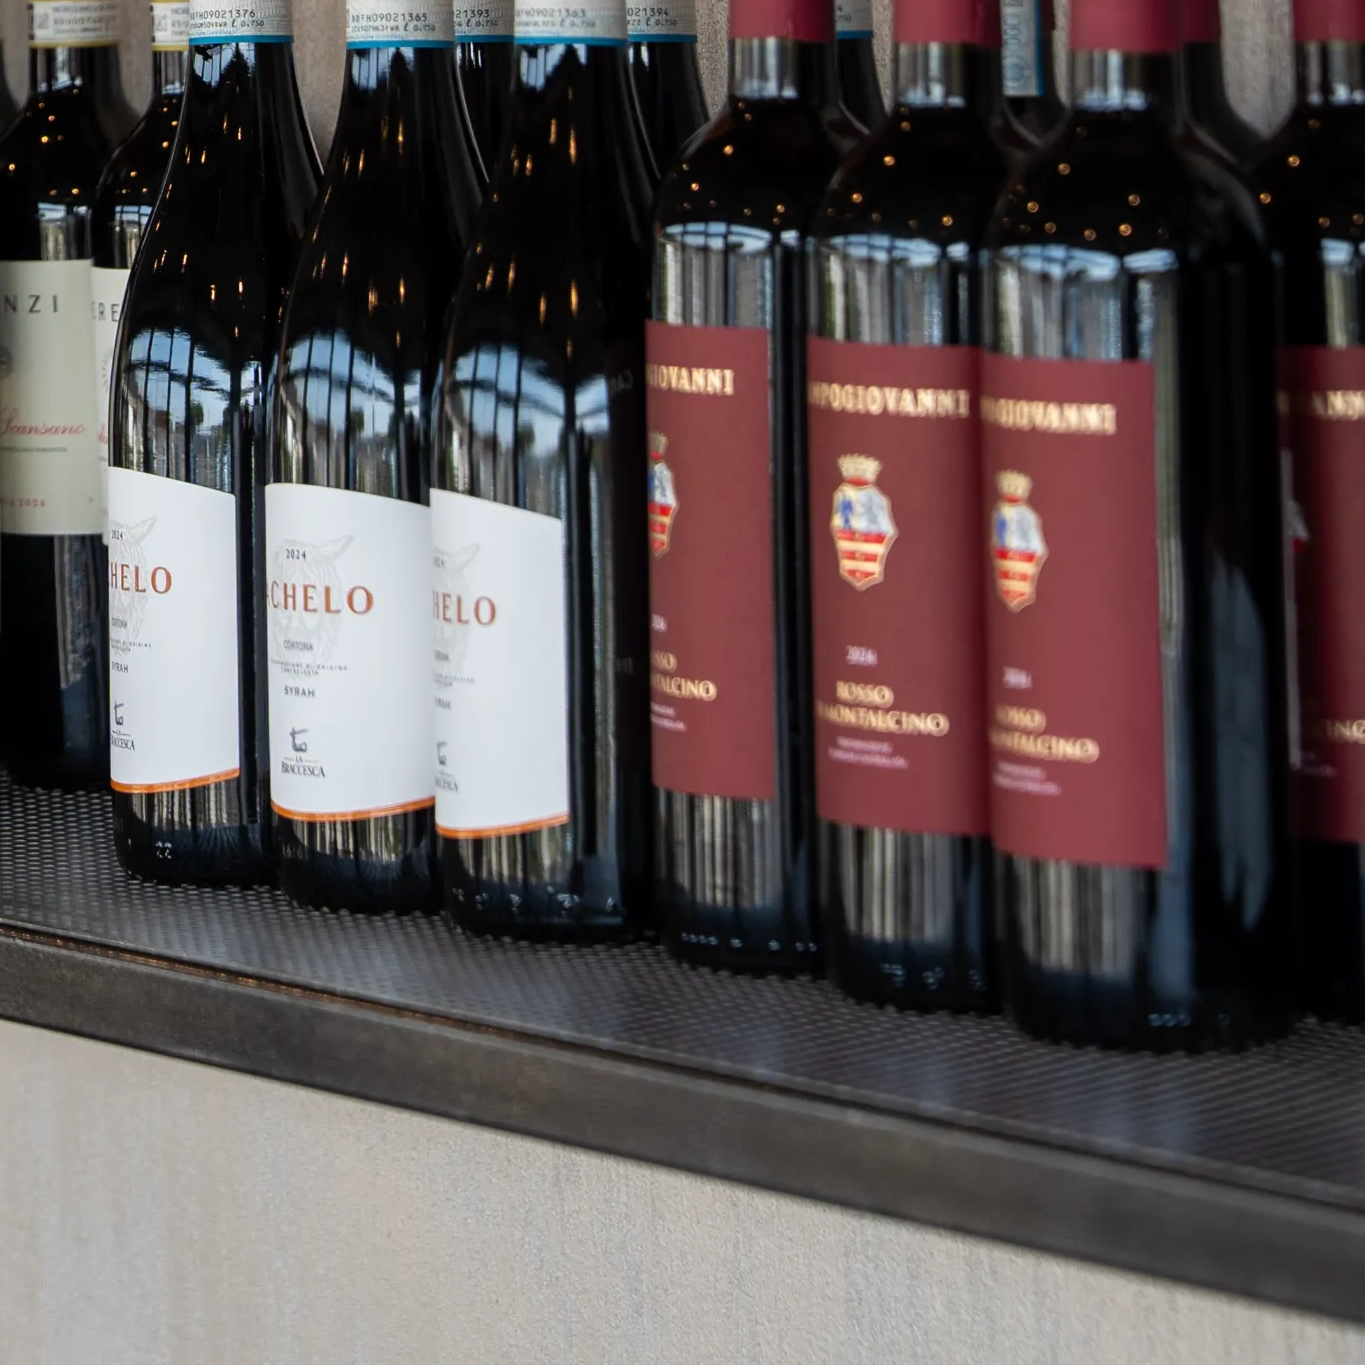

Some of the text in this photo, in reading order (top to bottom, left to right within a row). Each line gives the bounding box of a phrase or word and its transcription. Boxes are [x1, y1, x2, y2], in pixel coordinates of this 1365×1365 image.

[455, 9, 490, 19] 21393
[240, 19, 265, 28] 0.750
[285, 548, 307, 561] 2024
[267, 580, 374, 615] CHELO
[284, 685, 316, 698] SYRAH
[281, 760, 326, 778] BRACCESCA
